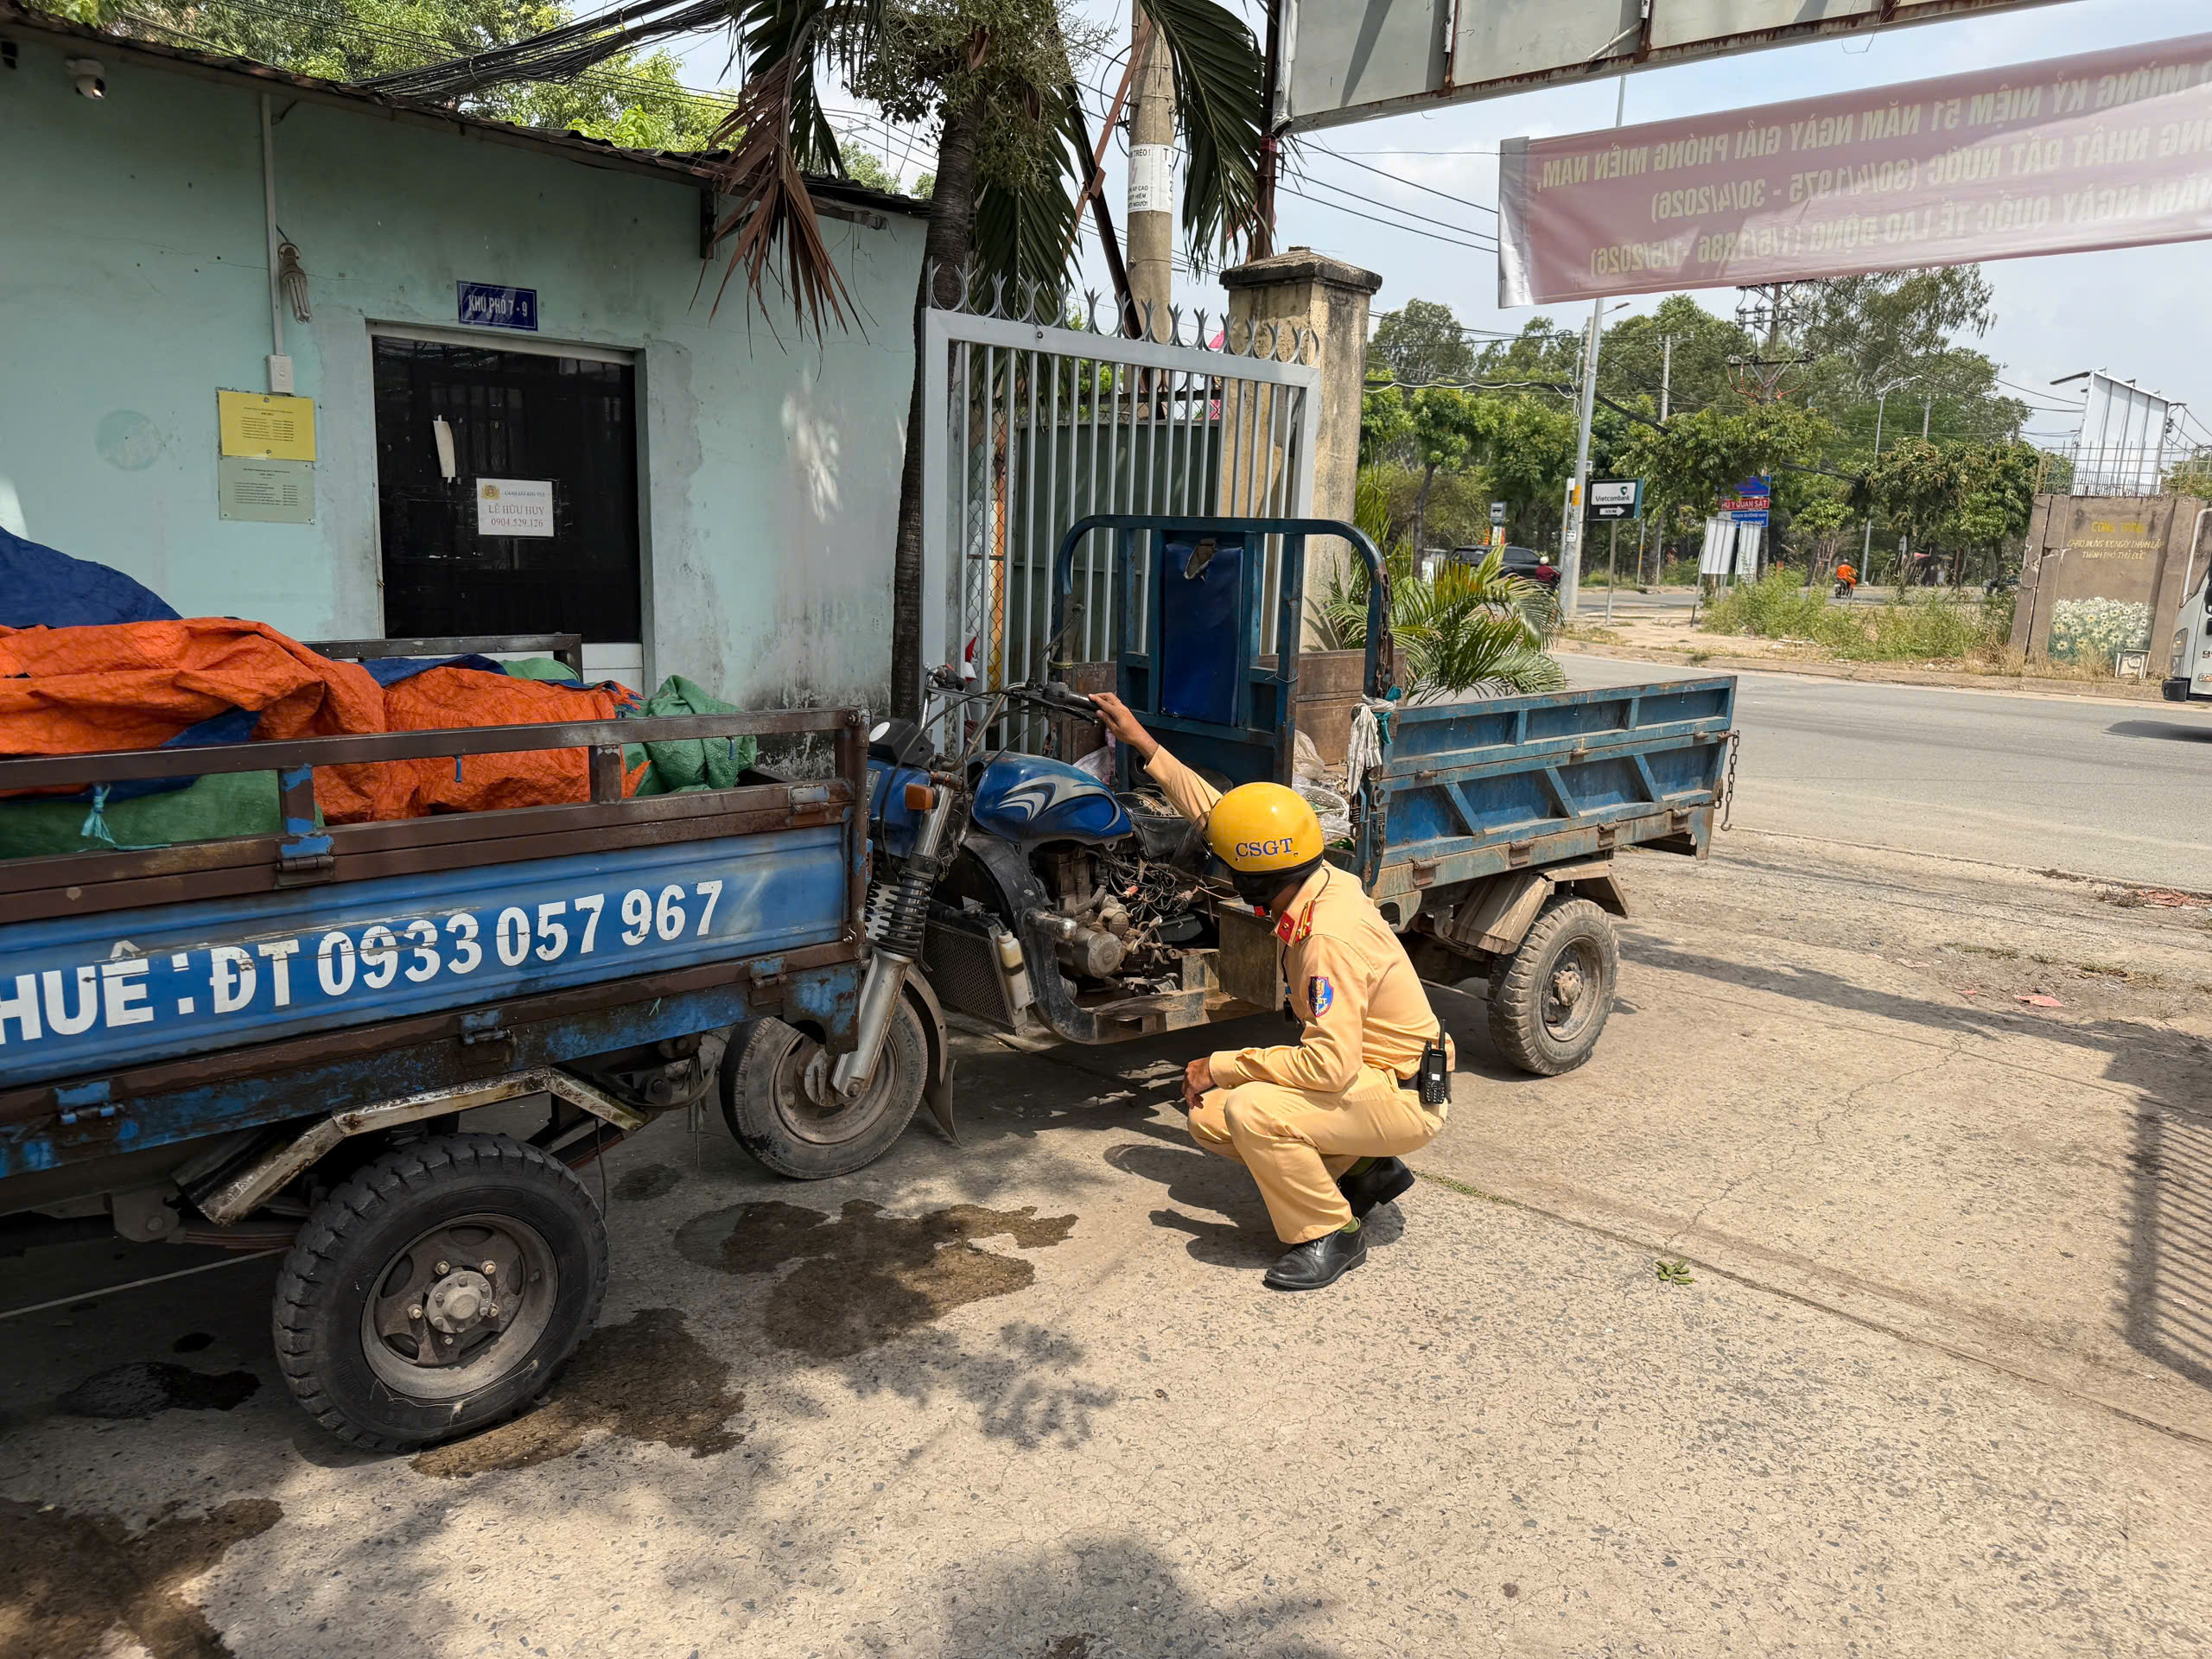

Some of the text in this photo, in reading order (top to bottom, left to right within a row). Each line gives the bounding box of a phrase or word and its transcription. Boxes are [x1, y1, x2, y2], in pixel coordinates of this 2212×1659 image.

[468, 294, 486, 314] KHU
[488, 293, 506, 315] PHỐ
[508, 299, 514, 315] 7
[522, 301, 528, 317] 9
[525, 505, 544, 515] HUY
[1236, 837, 1294, 857] CSGT
[209, 945, 300, 1015] ĐT
[316, 912, 482, 996] 0933
[495, 893, 605, 967] 057
[621, 880, 723, 946] 967
